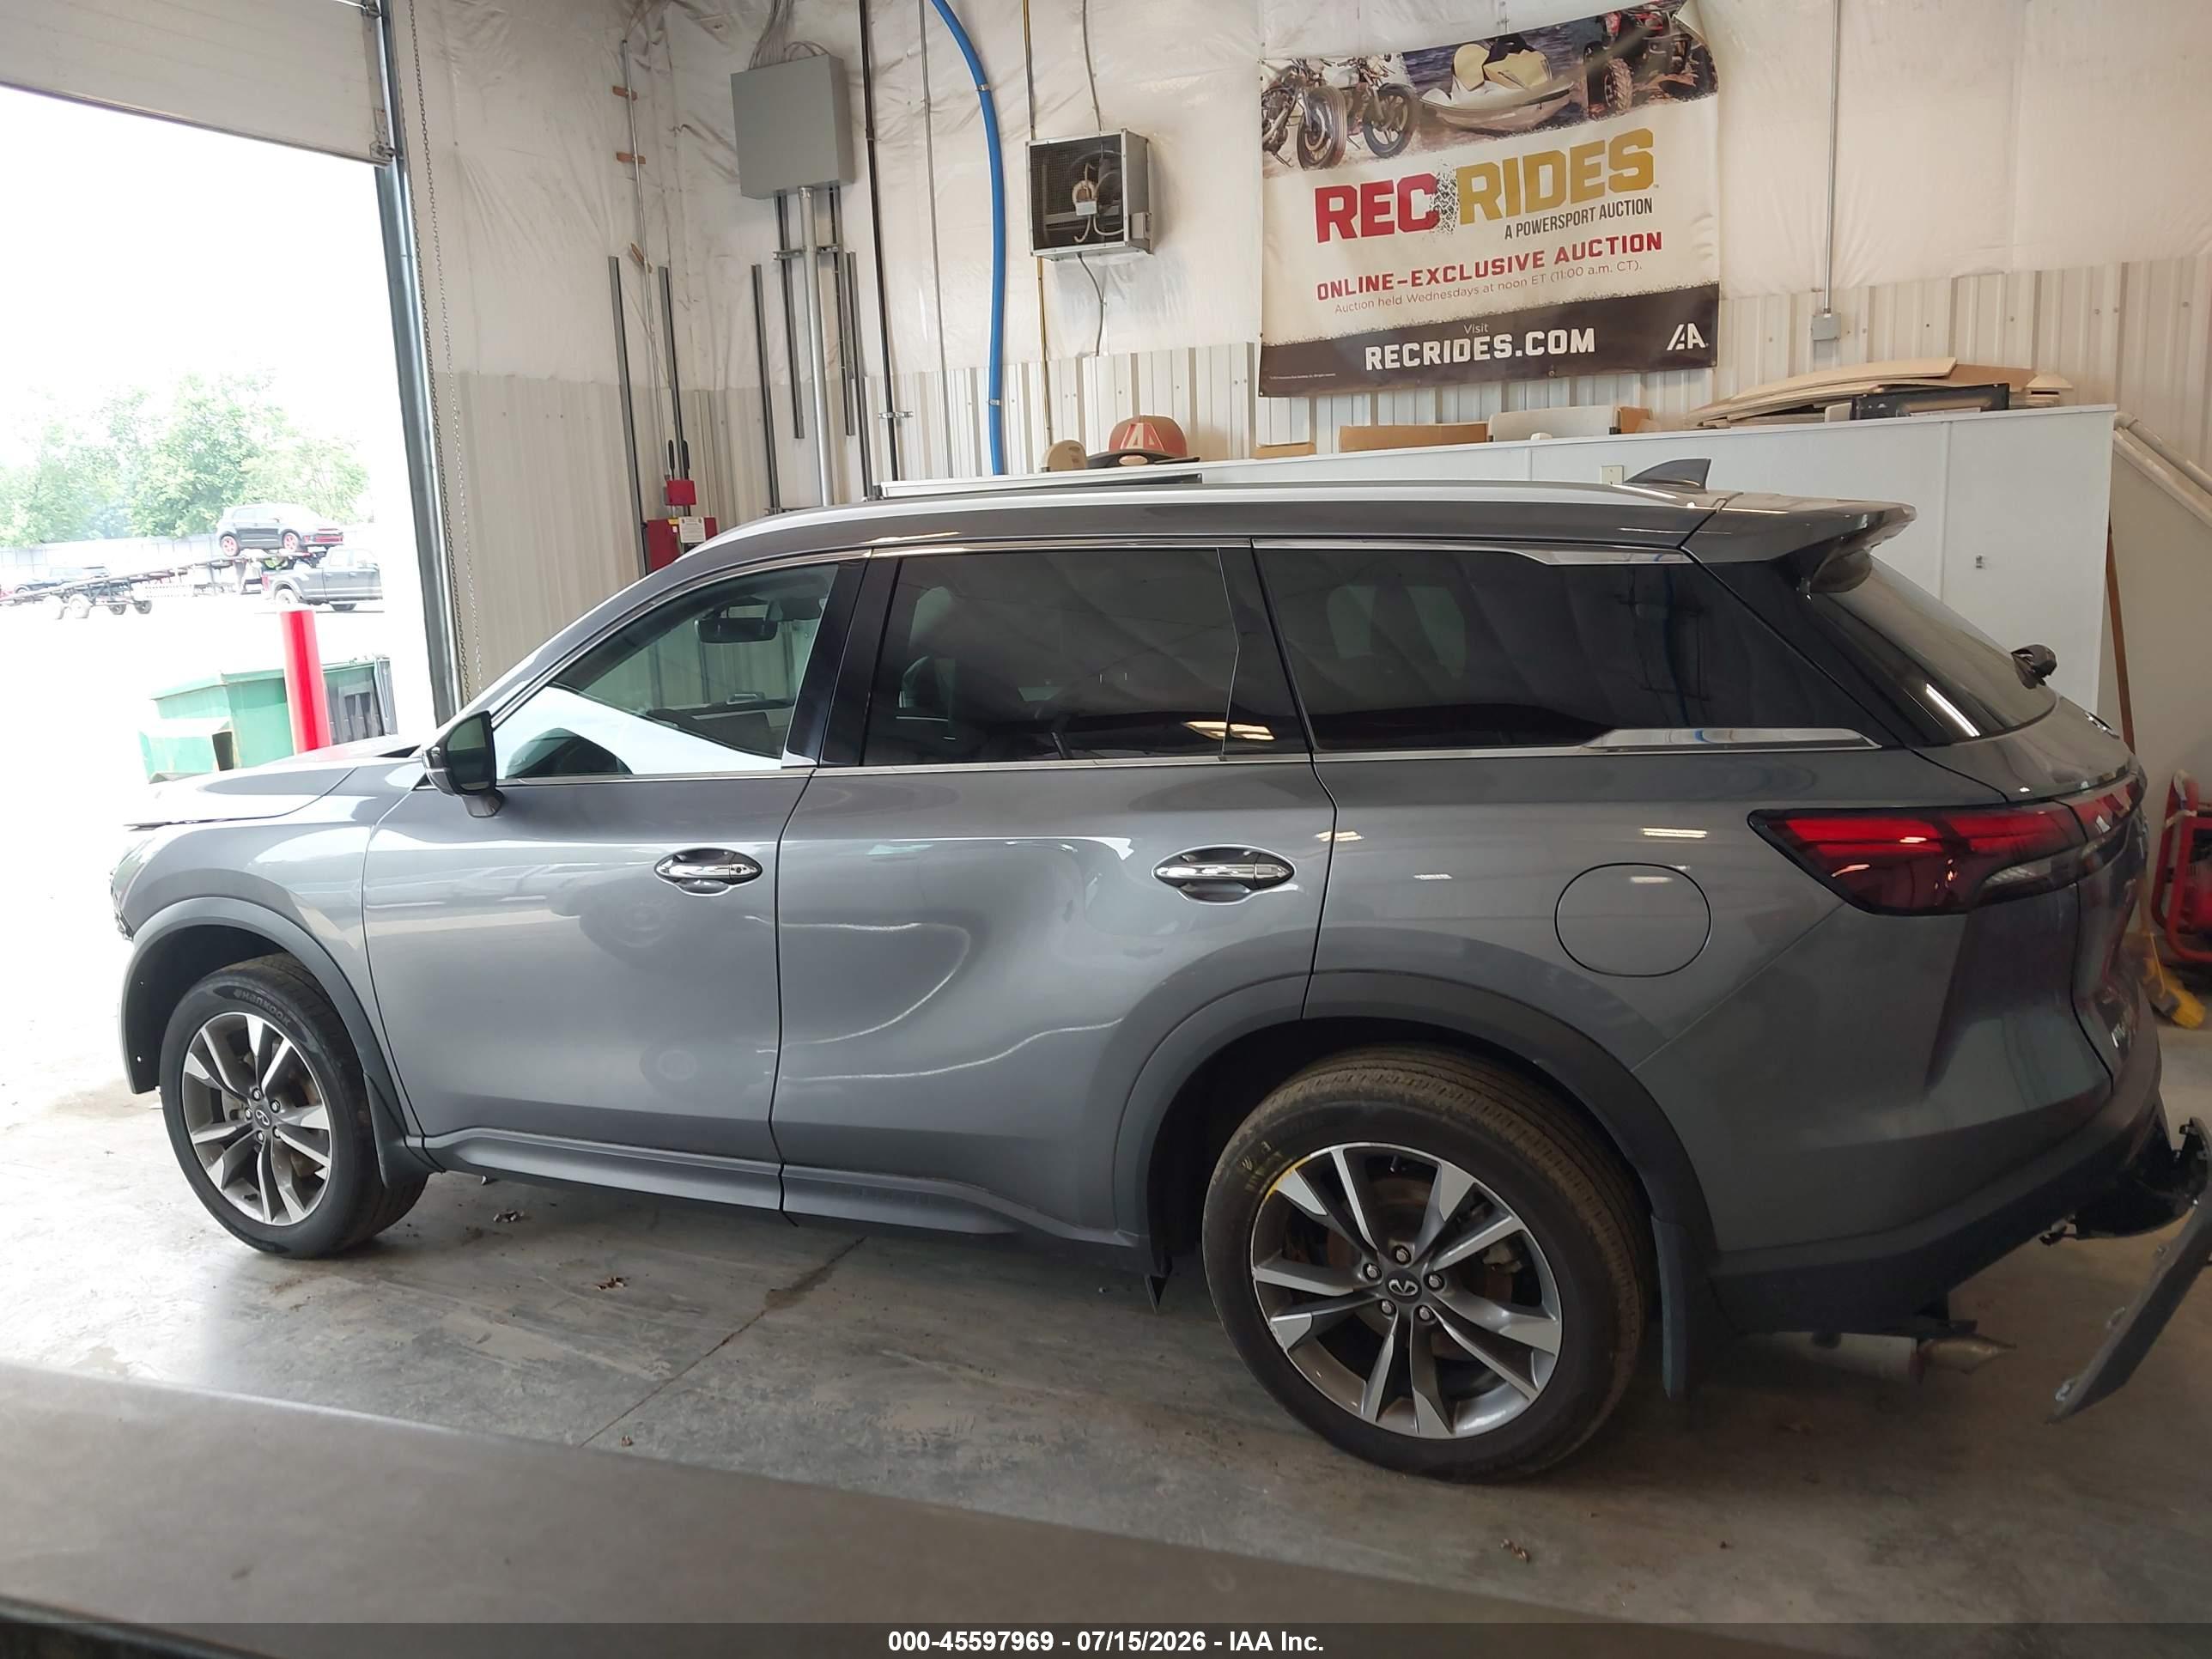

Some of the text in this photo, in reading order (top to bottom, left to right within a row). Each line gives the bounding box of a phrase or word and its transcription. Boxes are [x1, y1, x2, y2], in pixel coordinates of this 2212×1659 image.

[1315, 128, 1655, 243] REC RIDES
[1504, 198, 1653, 240] A POWERSPORT AUCTION
[1317, 232, 1662, 301] ONLINE-EXCLUSIVE AUCTION
[1334, 260, 1643, 314] Auction held Wednesdays at noon ET (11:00 a.m. CT).
[1365, 328, 1595, 371] RECRIDES.COM
[1463, 323, 1490, 335] Visit
